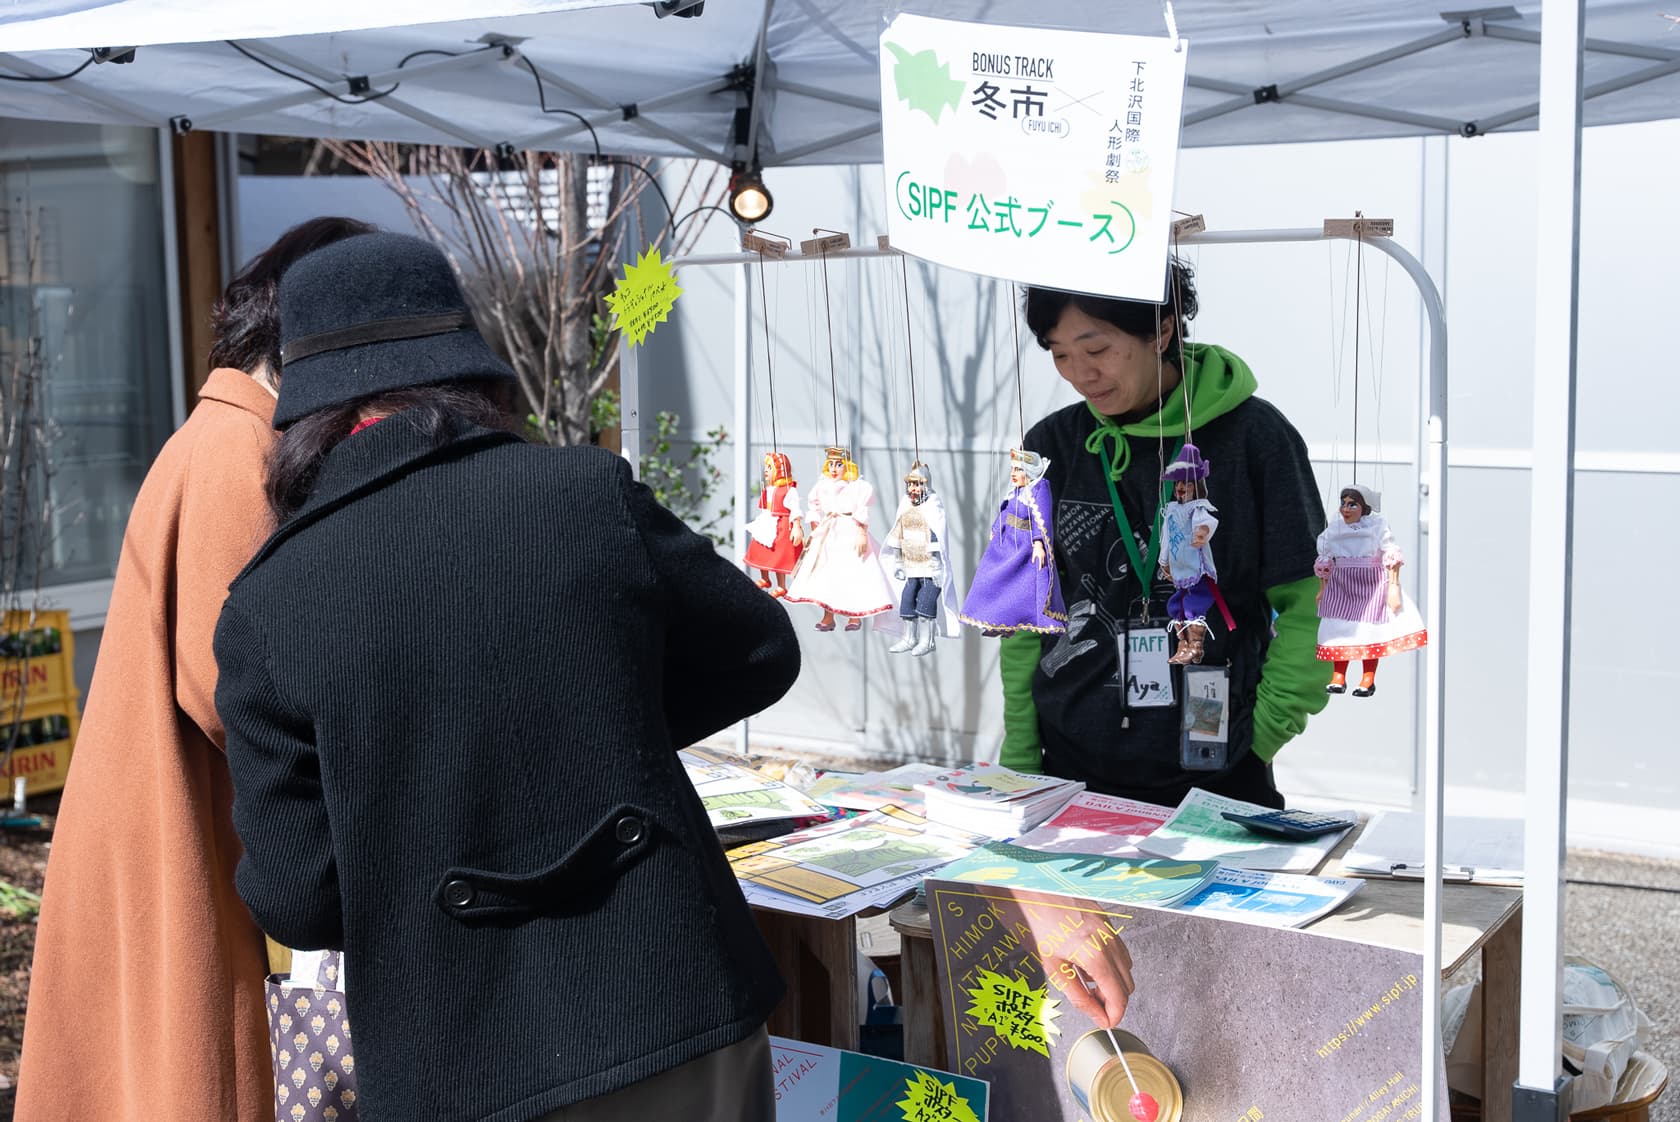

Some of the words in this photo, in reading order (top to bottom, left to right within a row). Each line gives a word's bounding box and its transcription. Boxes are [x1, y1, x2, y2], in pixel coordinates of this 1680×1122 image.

[972, 52, 1011, 75] BONUS
[1015, 56, 1054, 79] TRACK
[971, 81, 1048, 120] 冬市
[1125, 61, 1147, 143] 下北沢国際
[1105, 120, 1123, 184] 人形劇祭
[1060, 510, 1090, 536] TAZAWA
[1063, 508, 1110, 546] ERNATIONAL
[2, 663, 48, 690] IRIN
[1127, 675, 1161, 700] Aya
[948, 901, 964, 918] S
[1028, 908, 1041, 921] I
[951, 902, 1006, 960] HIMOK
[993, 984, 1034, 1009] SIPF
[1316, 974, 1418, 1058] https://www.sipf.jp
[775, 1059, 818, 1101] STIVAL
[925, 1080, 958, 1106] SIPF
